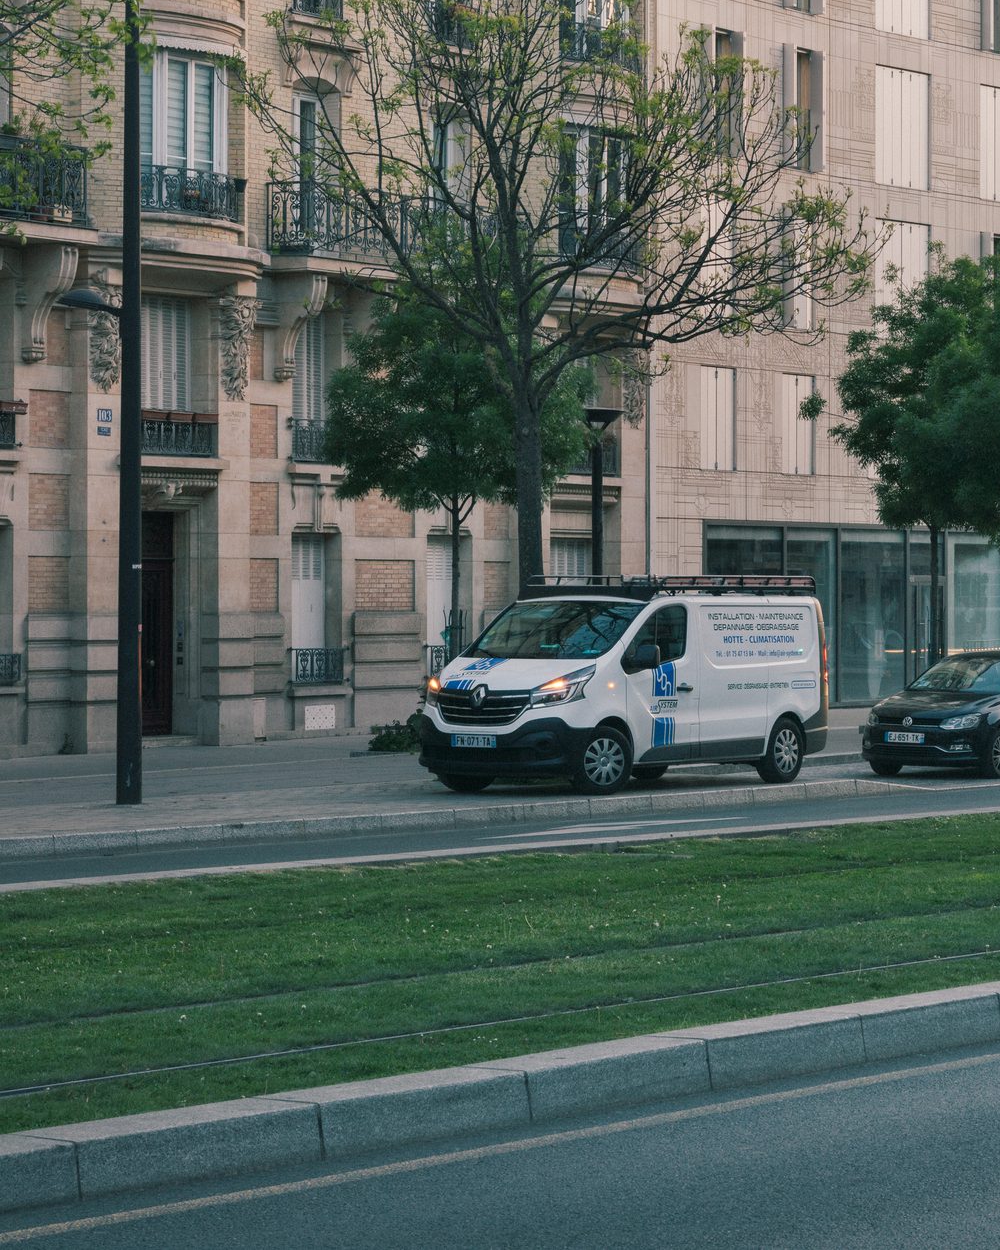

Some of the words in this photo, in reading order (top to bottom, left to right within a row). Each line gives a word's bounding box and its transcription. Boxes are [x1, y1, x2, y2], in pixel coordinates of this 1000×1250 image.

[98, 409, 112, 422] 103
[707, 613, 755, 621] INSTALLATION
[723, 635, 744, 643] HOTTE
[749, 635, 795, 643] CLIMATISATION
